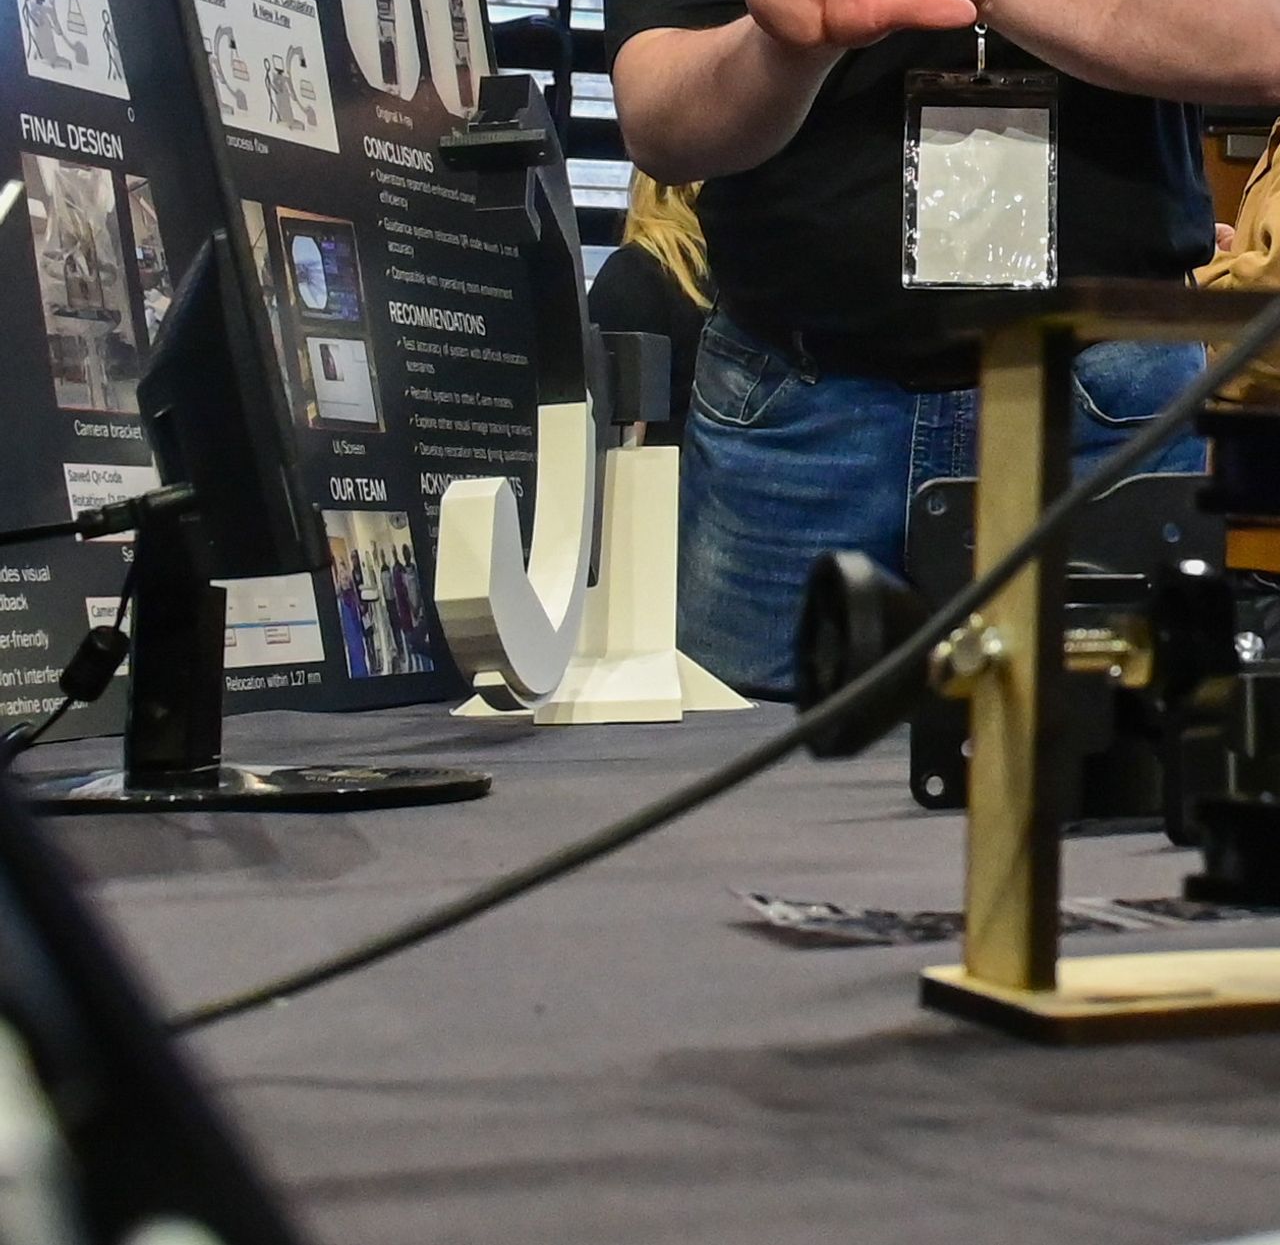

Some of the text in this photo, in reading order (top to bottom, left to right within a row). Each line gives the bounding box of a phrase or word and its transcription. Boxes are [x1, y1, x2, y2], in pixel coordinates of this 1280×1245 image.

[20, 112, 124, 161] FINAL DESIGN
[363, 135, 434, 173] CONCLUSIONS
[388, 300, 487, 337] RECOMMENDATIONS
[74, 419, 143, 441] Camera bracket
[329, 477, 387, 502] OUR TEAM
[21, 564, 51, 582] visual
[91, 605, 119, 618] Camer
[225, 673, 266, 692] Relocation
